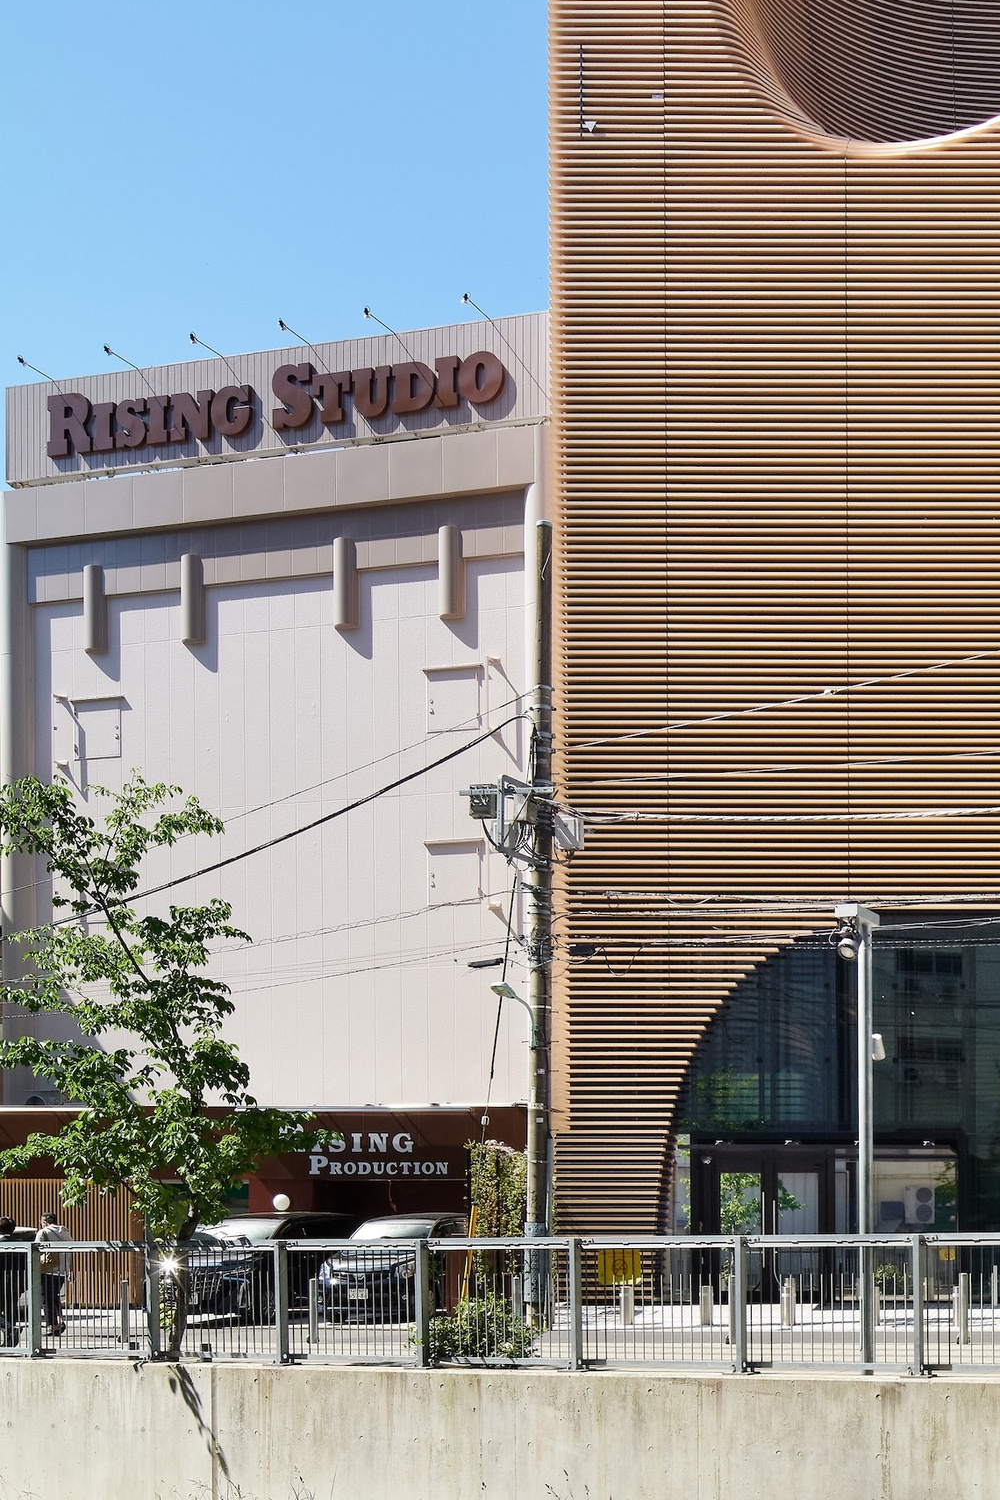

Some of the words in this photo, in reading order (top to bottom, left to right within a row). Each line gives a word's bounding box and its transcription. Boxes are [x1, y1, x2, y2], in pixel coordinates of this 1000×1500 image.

[47, 385, 254, 458] RISING
[272, 351, 505, 430] STUDIO
[309, 1155, 448, 1175] PRODUCTION
